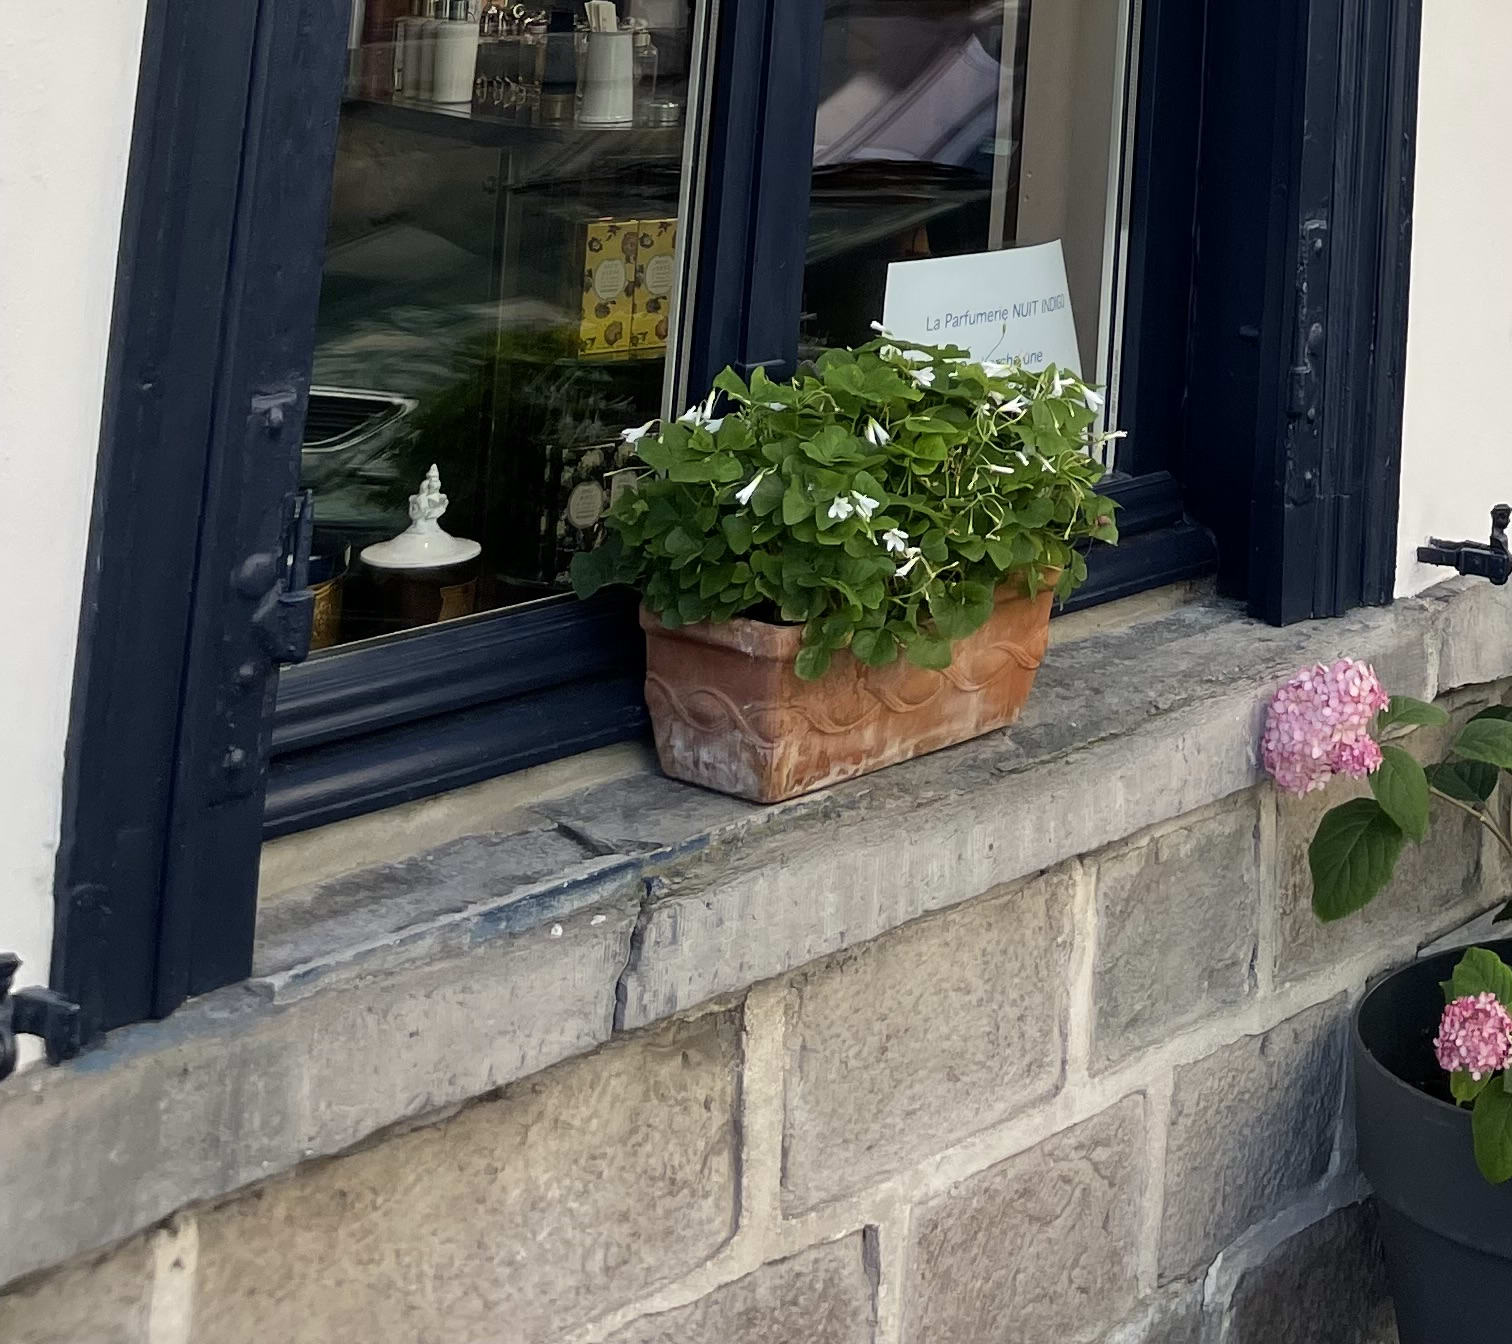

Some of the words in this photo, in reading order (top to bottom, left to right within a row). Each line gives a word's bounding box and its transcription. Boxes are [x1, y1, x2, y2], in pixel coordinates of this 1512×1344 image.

[926, 316, 941, 332] La
[944, 308, 1009, 329] Parfumerie
[1012, 299, 1039, 319] NUIT
